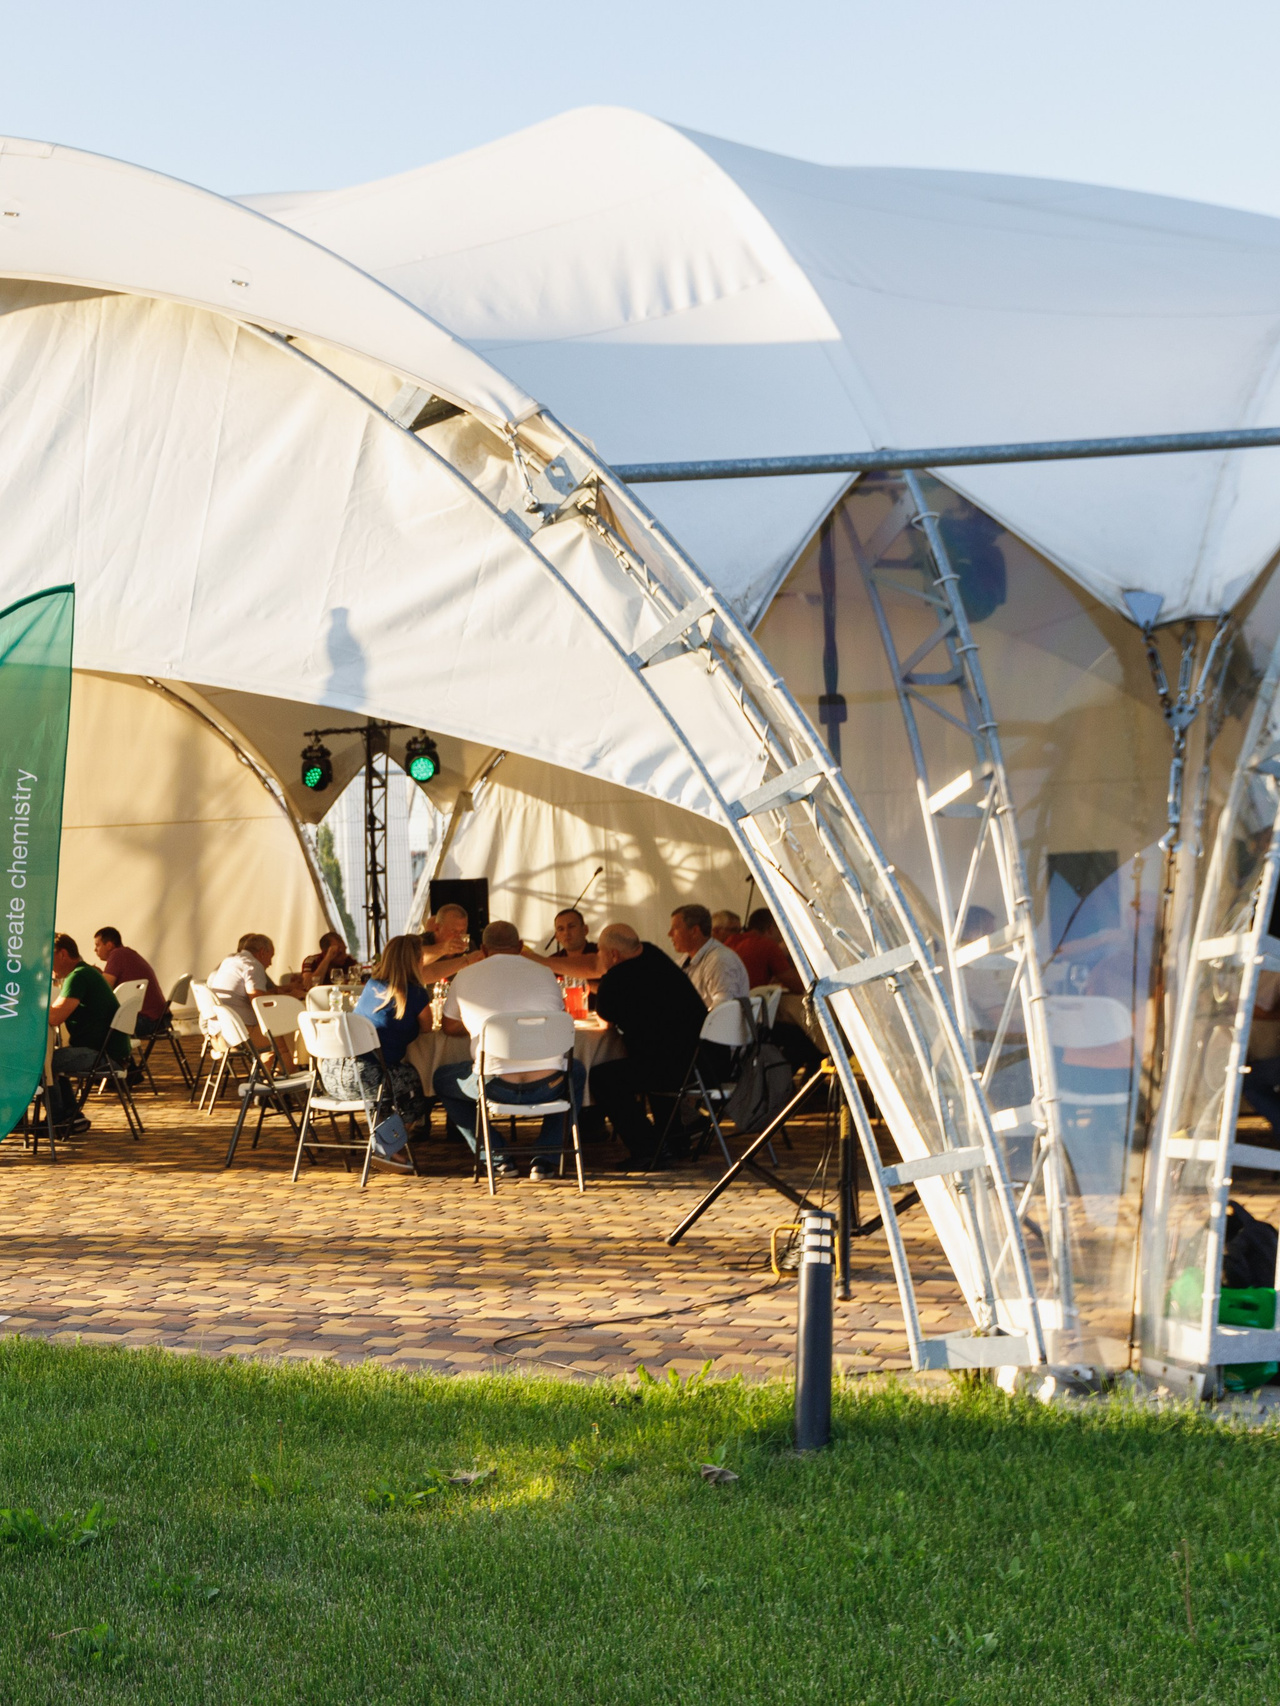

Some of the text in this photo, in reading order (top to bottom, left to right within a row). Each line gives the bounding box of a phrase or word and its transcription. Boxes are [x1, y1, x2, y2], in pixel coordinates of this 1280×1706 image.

[0, 769, 38, 1019] We create chemistry
